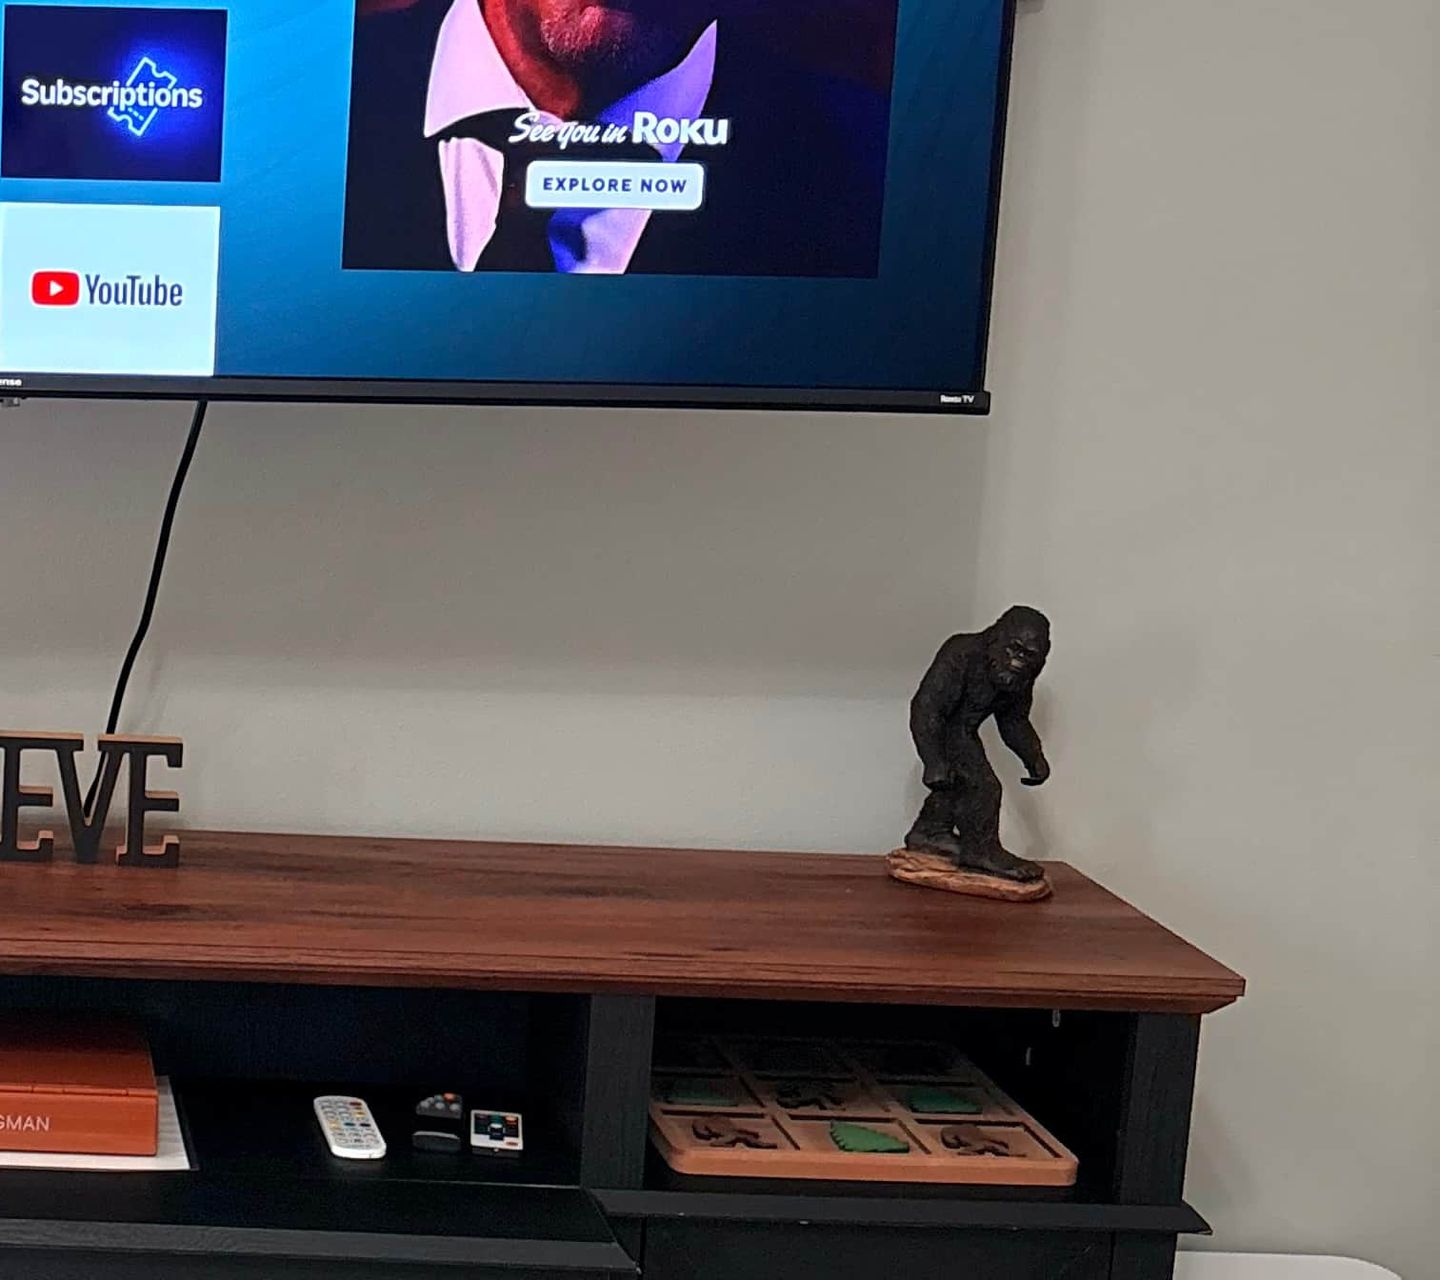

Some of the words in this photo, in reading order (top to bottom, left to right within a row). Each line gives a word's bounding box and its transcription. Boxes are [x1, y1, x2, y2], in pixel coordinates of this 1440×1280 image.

[21, 78, 204, 111] Subscriptions
[509, 110, 554, 144] See
[558, 120, 600, 150] you
[601, 122, 628, 145] in
[632, 111, 728, 146] Roku
[543, 177, 632, 192] EXPLORE
[640, 179, 687, 194] NOW
[85, 274, 183, 307] YouTube
